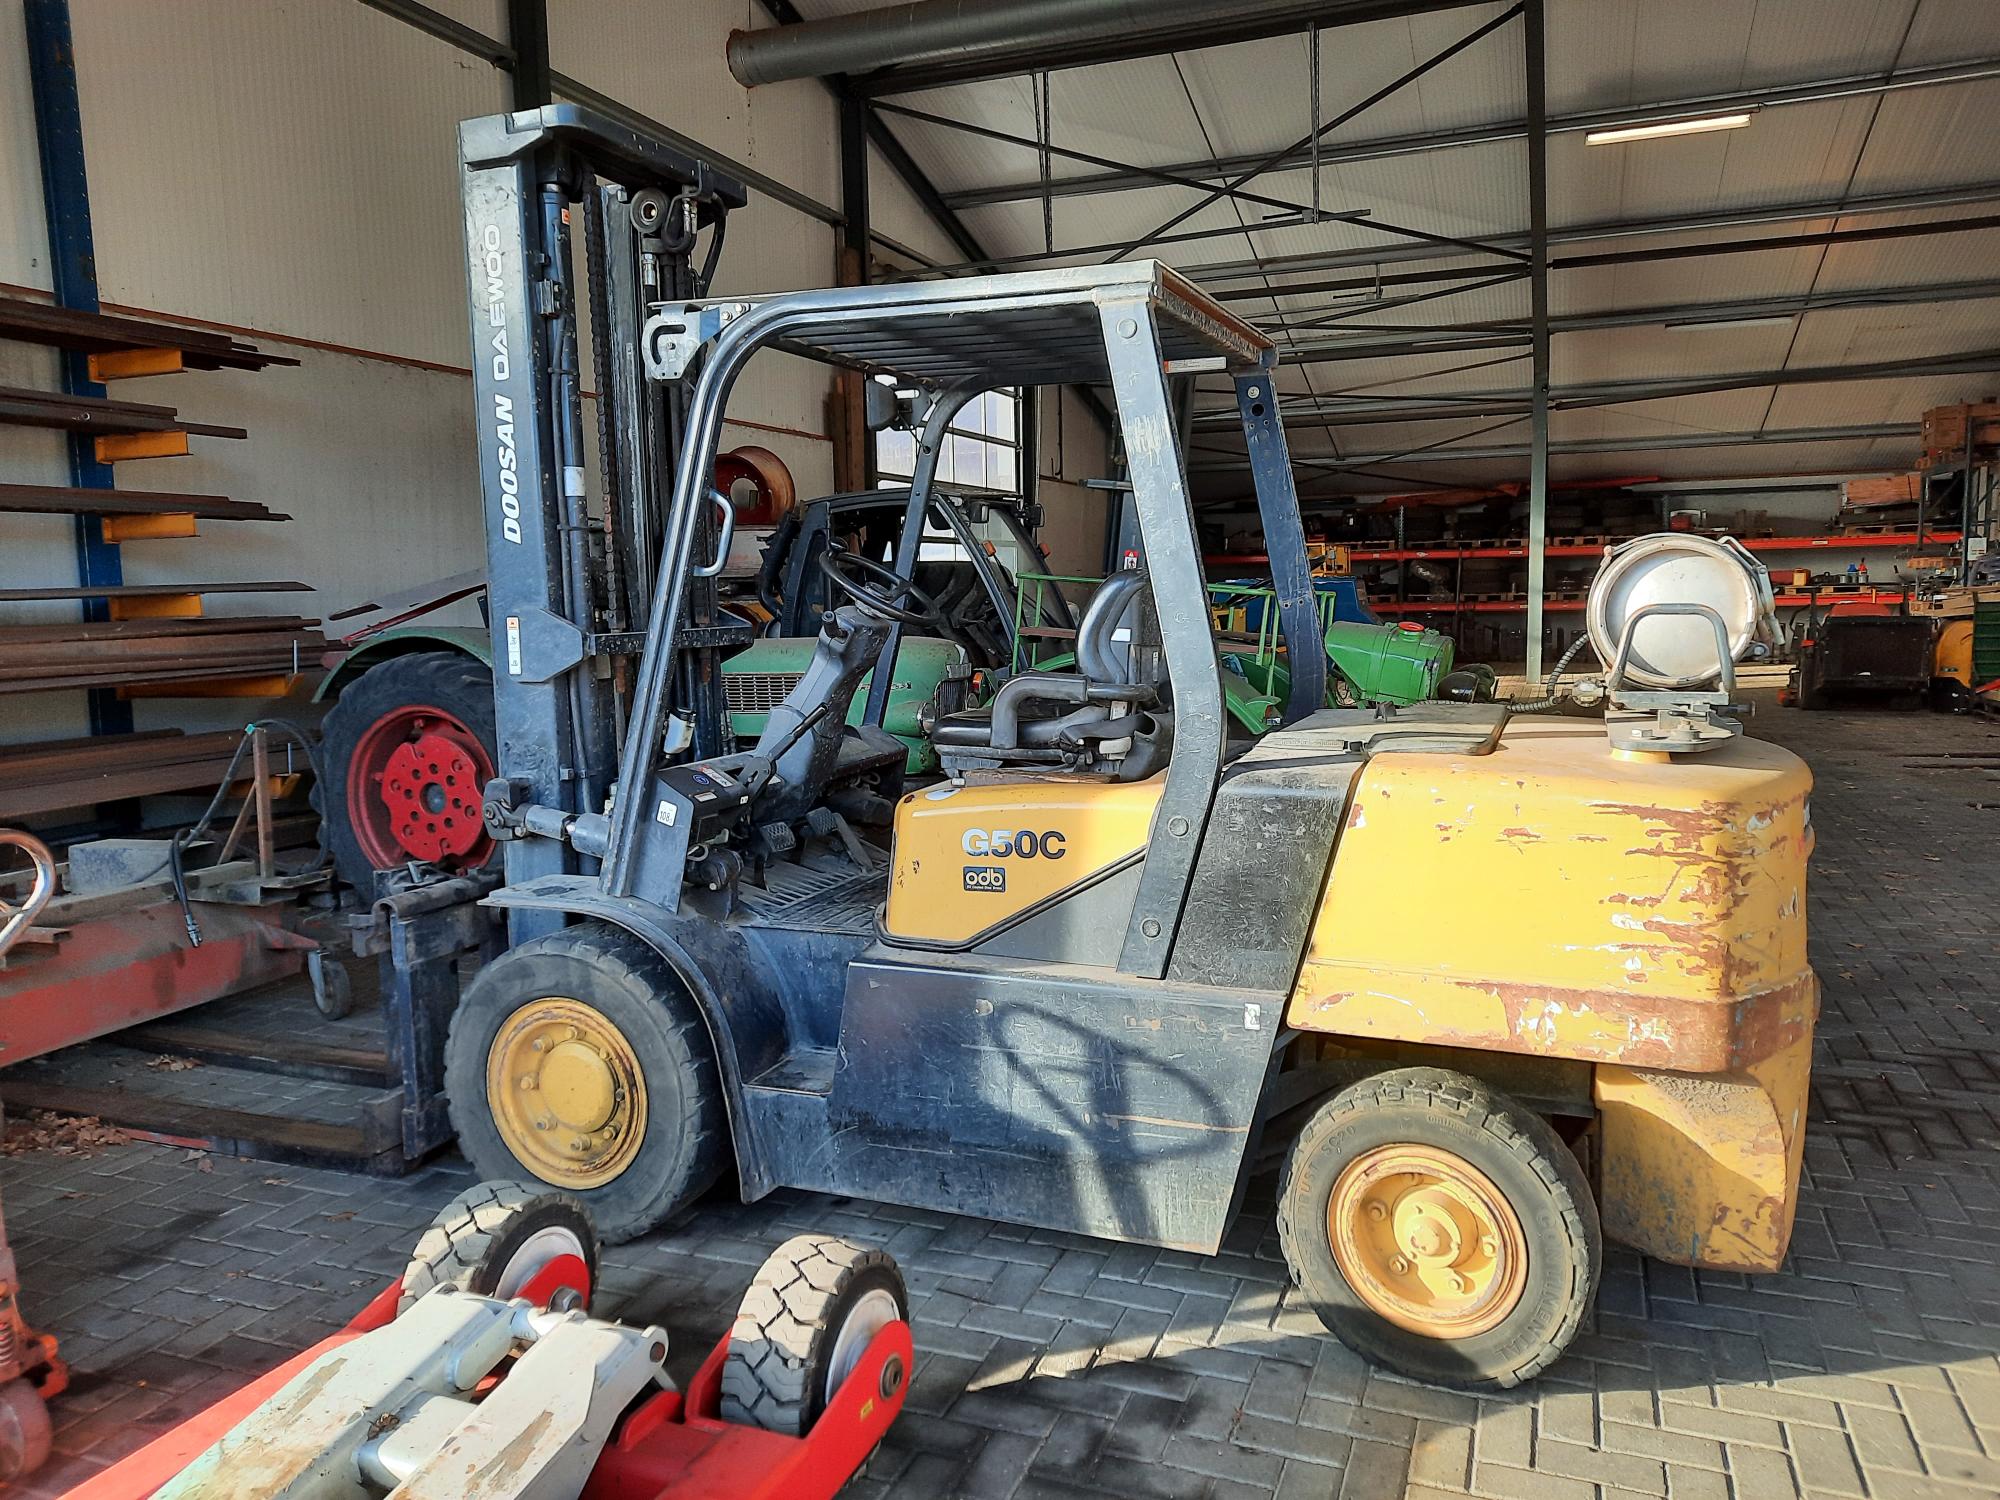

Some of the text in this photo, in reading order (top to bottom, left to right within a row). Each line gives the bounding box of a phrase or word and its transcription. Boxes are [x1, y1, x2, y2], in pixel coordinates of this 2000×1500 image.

[484, 223, 523, 545] DOOSAN DAEWOO
[961, 829, 1066, 860] G50C
[965, 868, 1003, 886] odb
